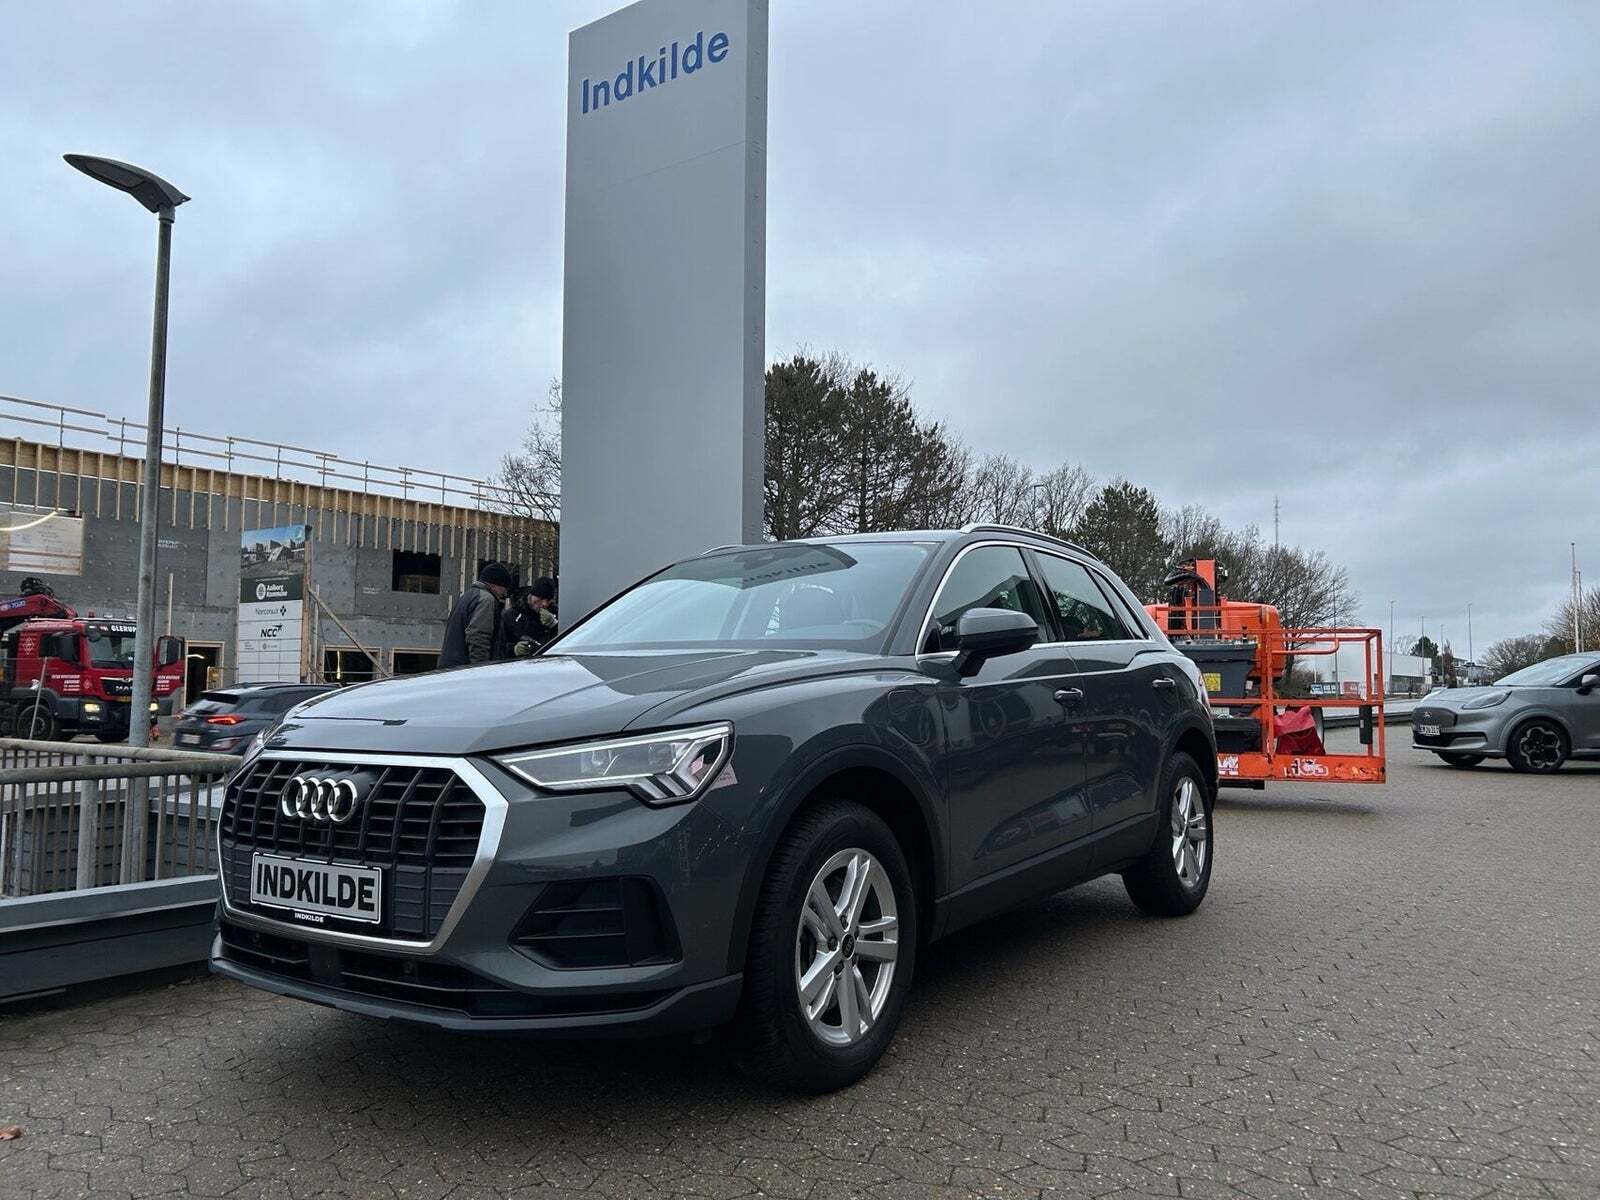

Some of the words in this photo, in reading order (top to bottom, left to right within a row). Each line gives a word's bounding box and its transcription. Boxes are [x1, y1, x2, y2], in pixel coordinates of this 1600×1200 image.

[582, 31, 729, 114] Indkilde
[261, 628, 278, 637] NCC
[256, 863, 375, 912] INDKILDE
[294, 912, 324, 923] INDKILDE
